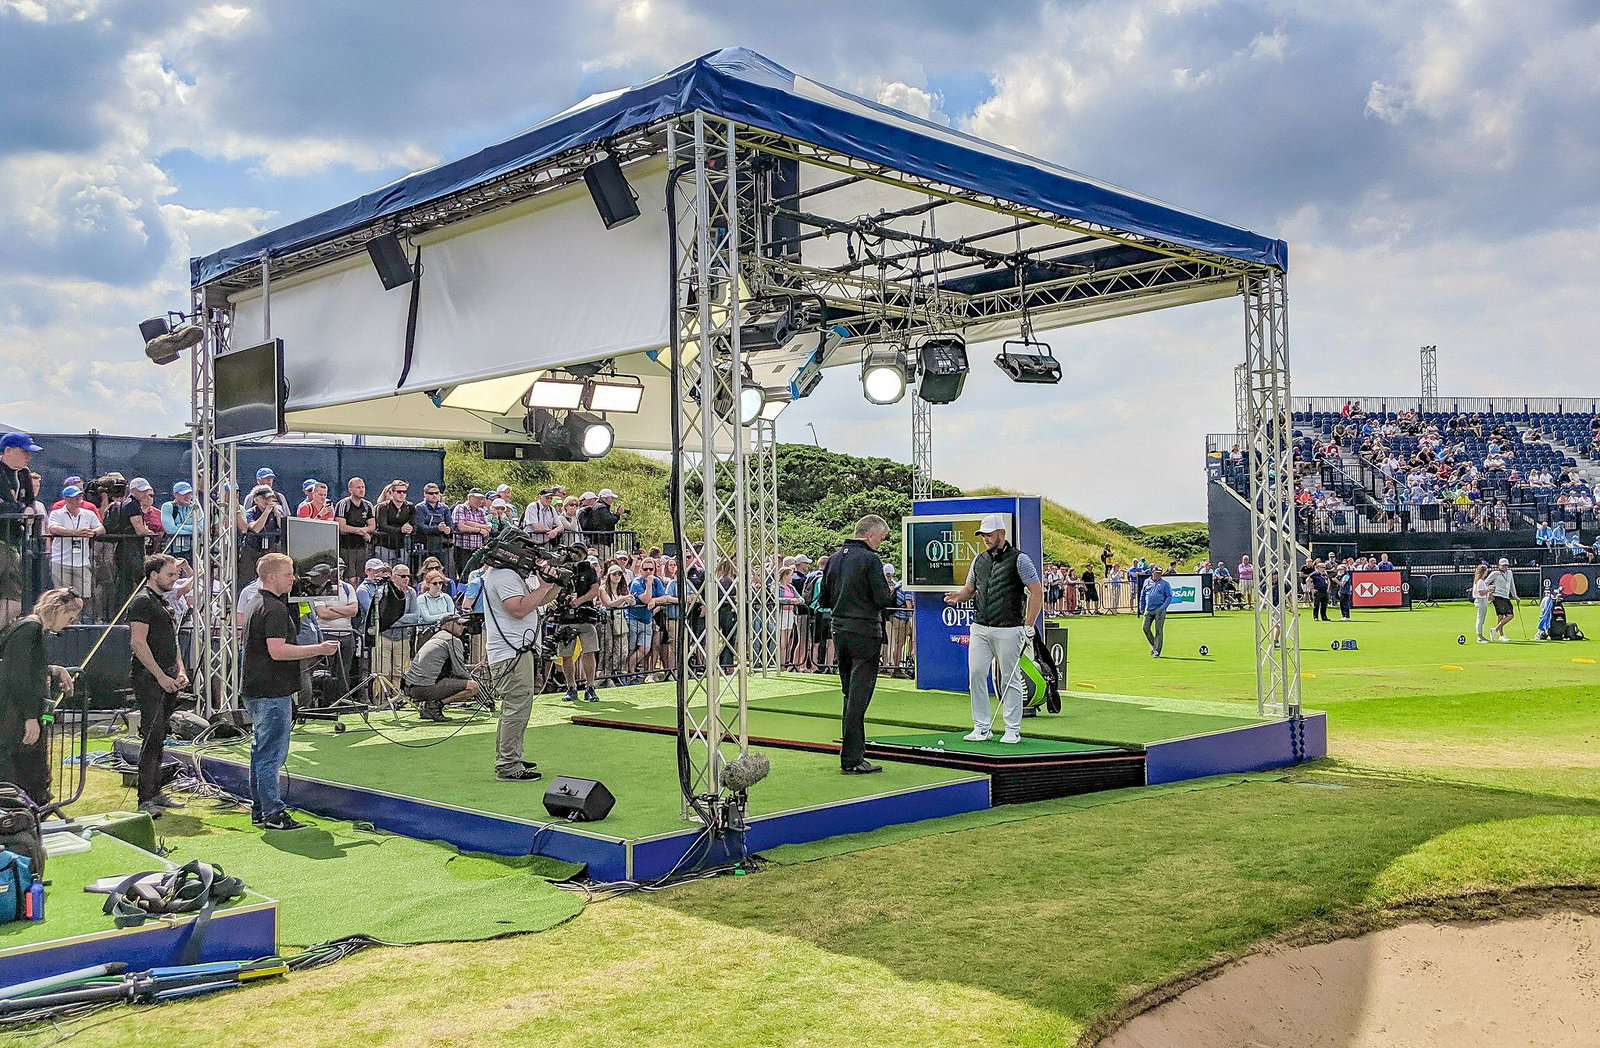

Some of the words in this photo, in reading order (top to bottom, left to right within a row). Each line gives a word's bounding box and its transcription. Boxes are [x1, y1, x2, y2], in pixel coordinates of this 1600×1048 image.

[941, 530, 964, 541] THE
[926, 540, 980, 562] OPEN
[1380, 585, 1400, 593] HSBC
[942, 606, 976, 627] OPE
